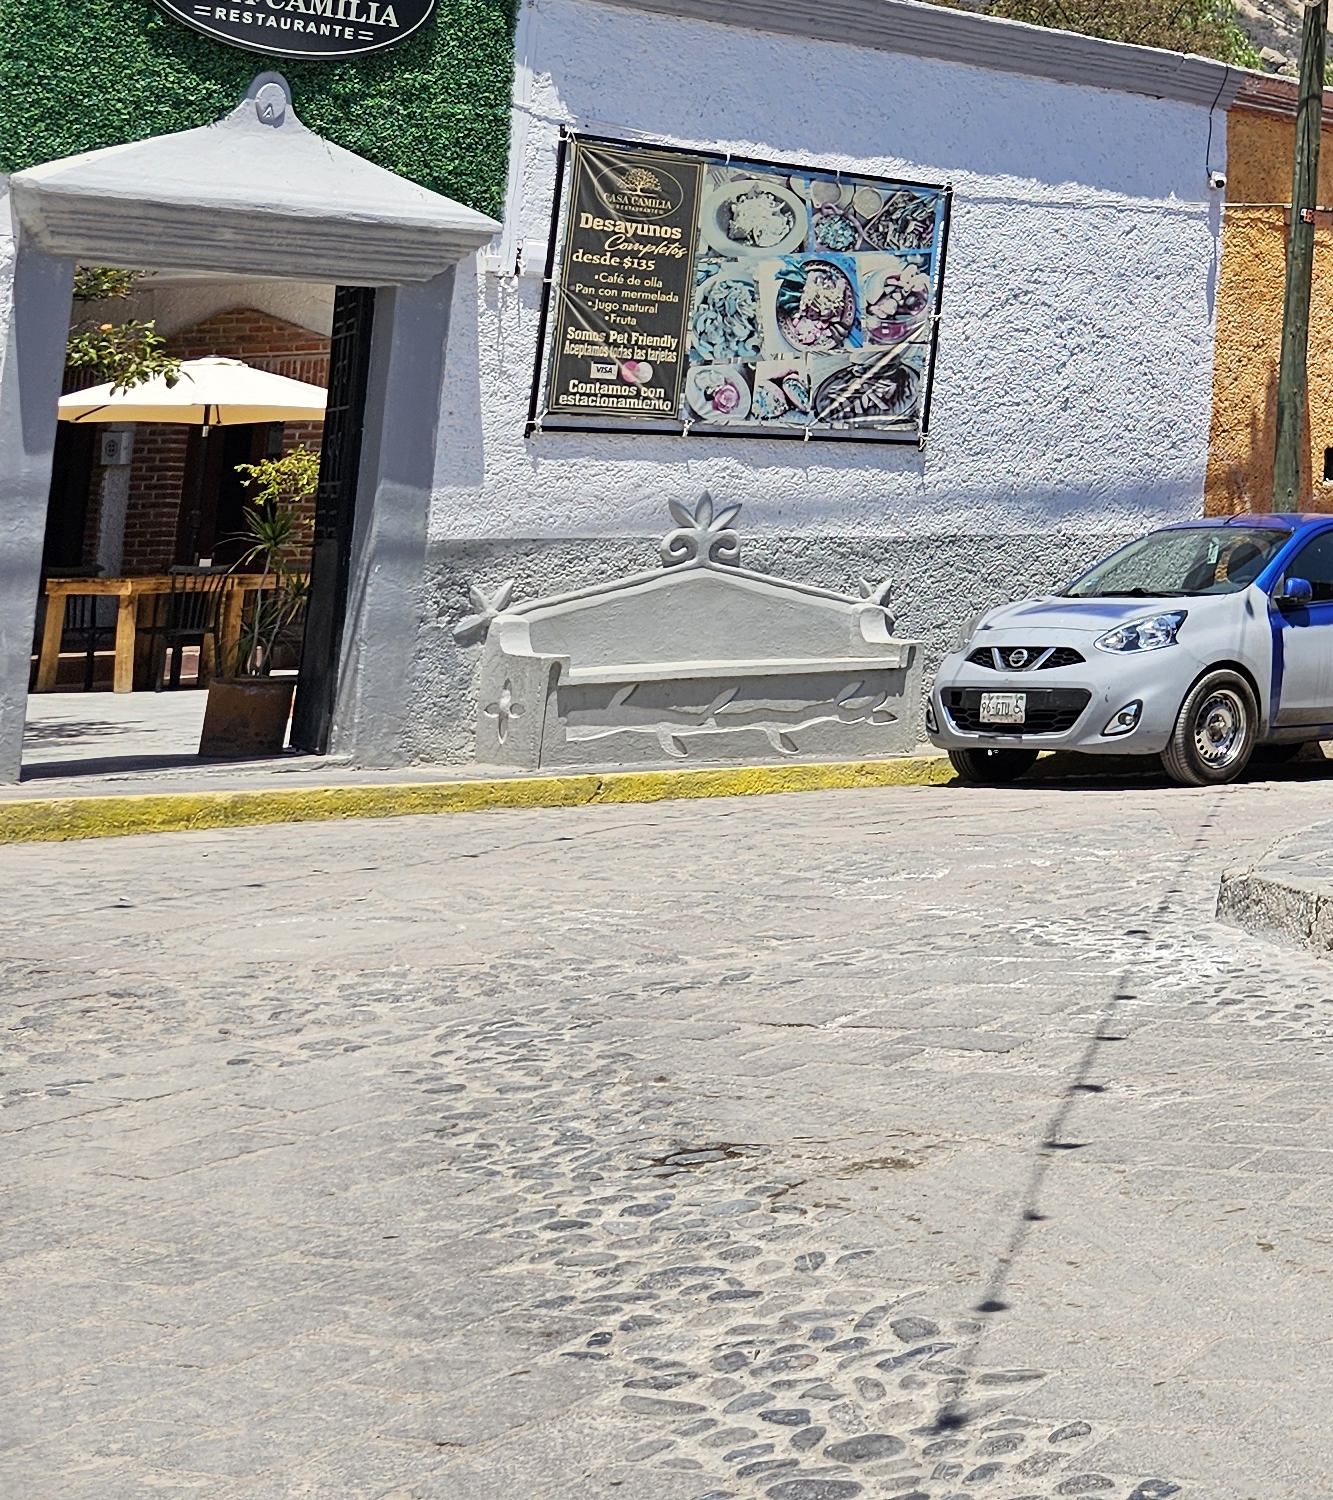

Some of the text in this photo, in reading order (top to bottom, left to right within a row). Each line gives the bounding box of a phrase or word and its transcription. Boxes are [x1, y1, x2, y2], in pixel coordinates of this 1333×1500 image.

[215, 7, 355, 40] RESTAURANTE
[603, 192, 672, 210] CASA CAMILIA
[580, 212, 682, 239] Desayunos
[604, 233, 687, 258] Completos
[572, 249, 656, 270] desde $135
[599, 272, 663, 288] Café de olla
[575, 283, 679, 303] Pan con mermelada
[593, 299, 659, 313] Jugo natural
[610, 313, 637, 325] Fruta
[566, 326, 678, 350] Somos Pet Friendly
[563, 340, 678, 364] Aceptamos todas las tarjetas
[596, 366, 613, 374] VISA
[568, 379, 665, 398] Contamos con
[558, 394, 672, 412] estacionamiento
